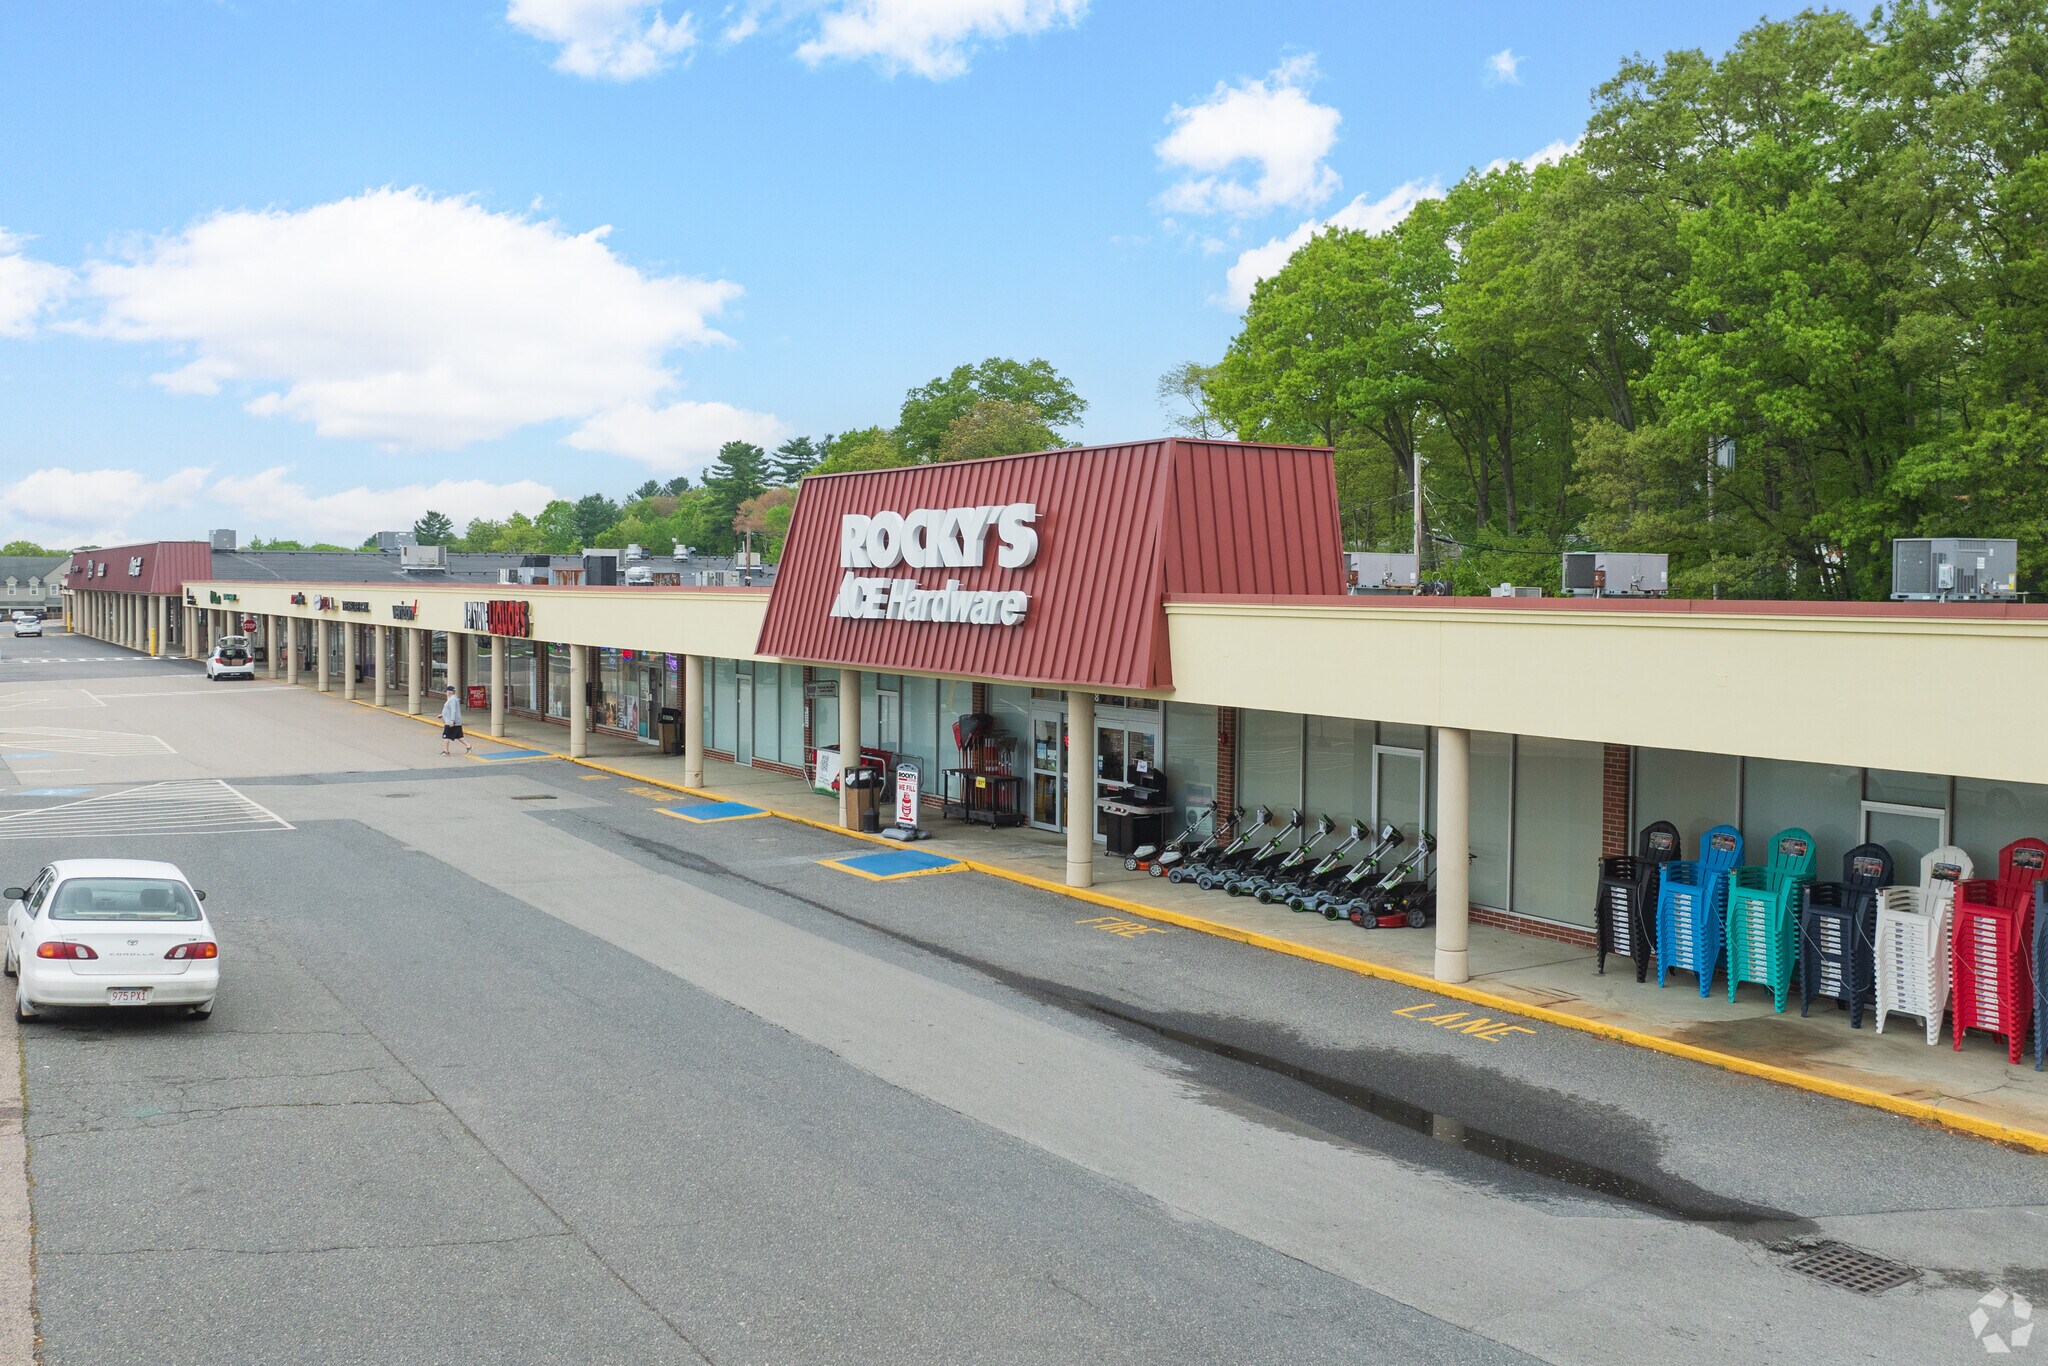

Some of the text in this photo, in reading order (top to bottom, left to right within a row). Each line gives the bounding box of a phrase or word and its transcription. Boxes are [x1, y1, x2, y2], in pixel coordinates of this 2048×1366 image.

[841, 503, 1039, 569] ROCKY'S
[392, 600, 417, 621] verizon
[830, 571, 1028, 626] ACE Hardware
[488, 600, 529, 638] LIQUORS
[1075, 917, 1168, 939] FIRE
[112, 991, 146, 1001] 975 PX1
[1391, 1003, 1537, 1042] LANE
